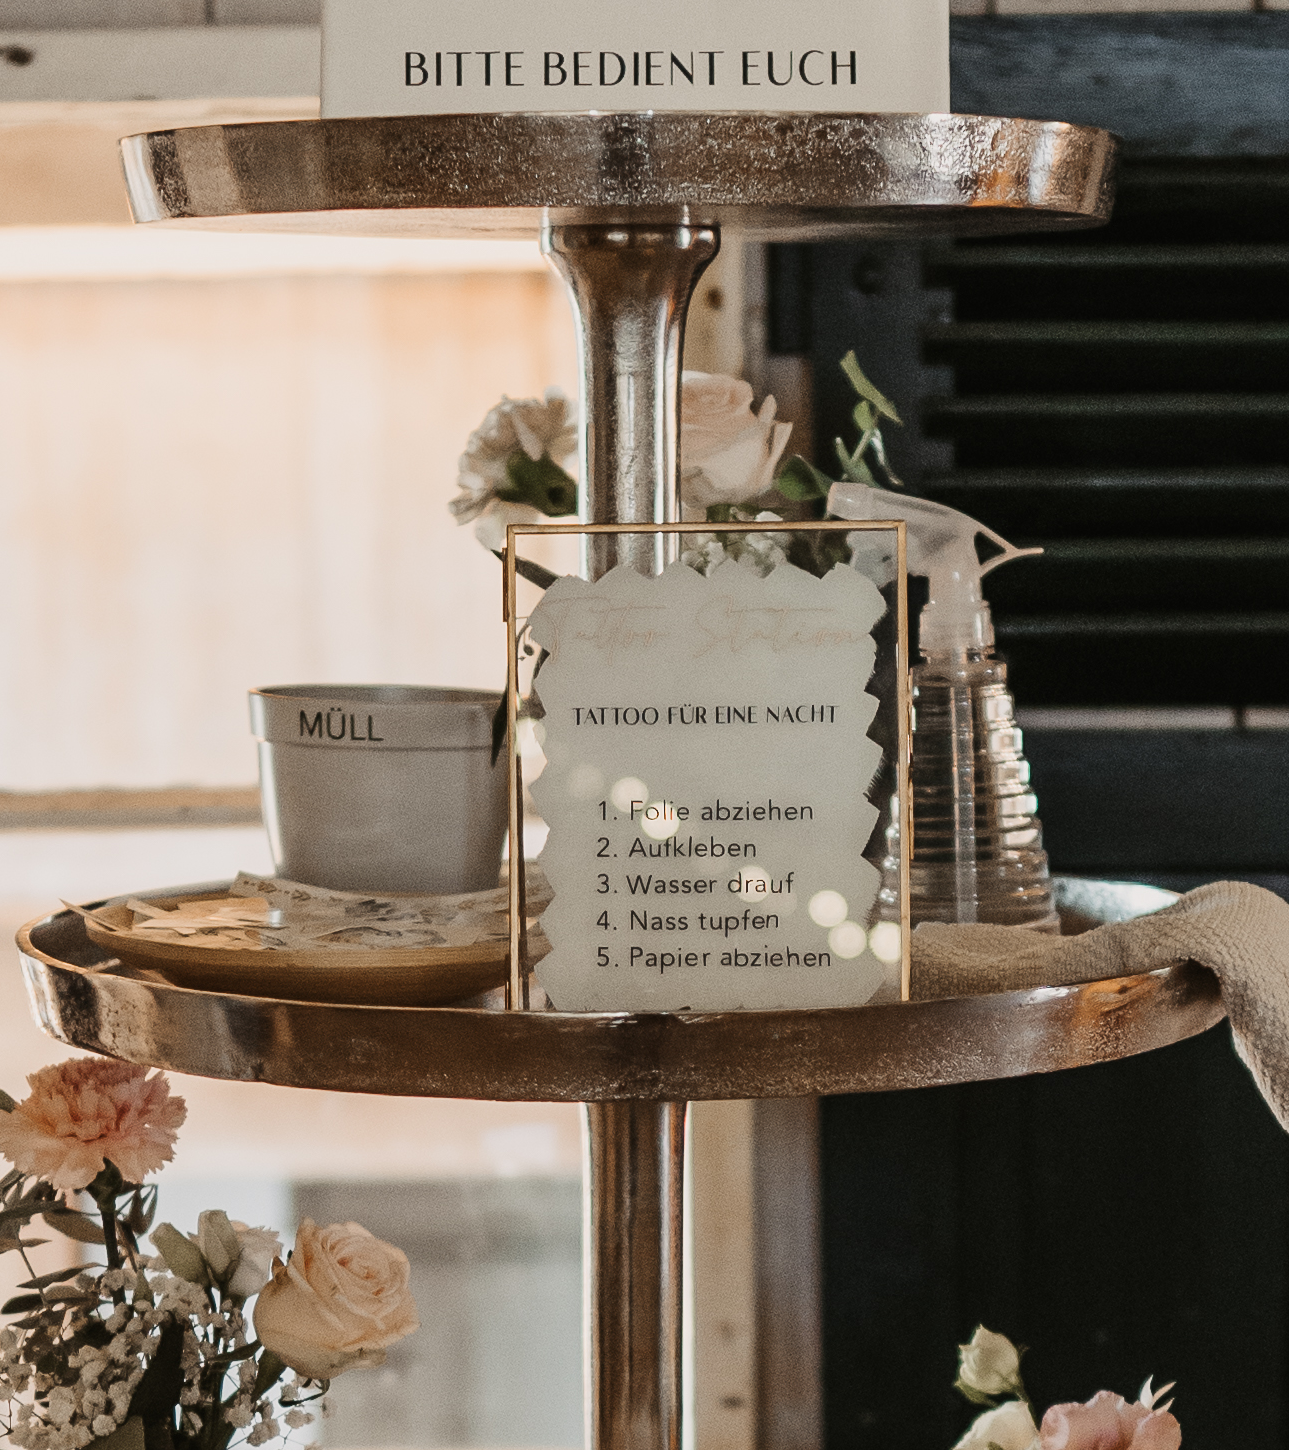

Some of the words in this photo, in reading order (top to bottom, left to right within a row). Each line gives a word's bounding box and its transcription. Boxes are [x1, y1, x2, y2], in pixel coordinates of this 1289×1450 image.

[404, 51, 522, 87] BITTE
[543, 51, 724, 87] BEDIENT
[741, 50, 857, 86] EUCH
[298, 706, 384, 742] MÜLL
[572, 706, 660, 726] TATTOO
[667, 706, 707, 725] FÜR
[714, 705, 758, 725] EINE
[765, 704, 839, 724] NACHT
[598, 800, 618, 822] 1.
[629, 799, 690, 822] Folie
[700, 799, 814, 822] abziehen
[596, 836, 618, 859] 2.
[628, 835, 757, 859] Aufkleben
[596, 872, 618, 895] 3.
[625, 874, 718, 896] Wasser
[727, 871, 794, 895] drauf
[595, 909, 617, 931] 4.
[629, 909, 689, 932] Nass
[697, 908, 779, 938] tupfen
[596, 946, 619, 968] 5.
[629, 945, 711, 975] Papier
[719, 944, 831, 968] abziehen
